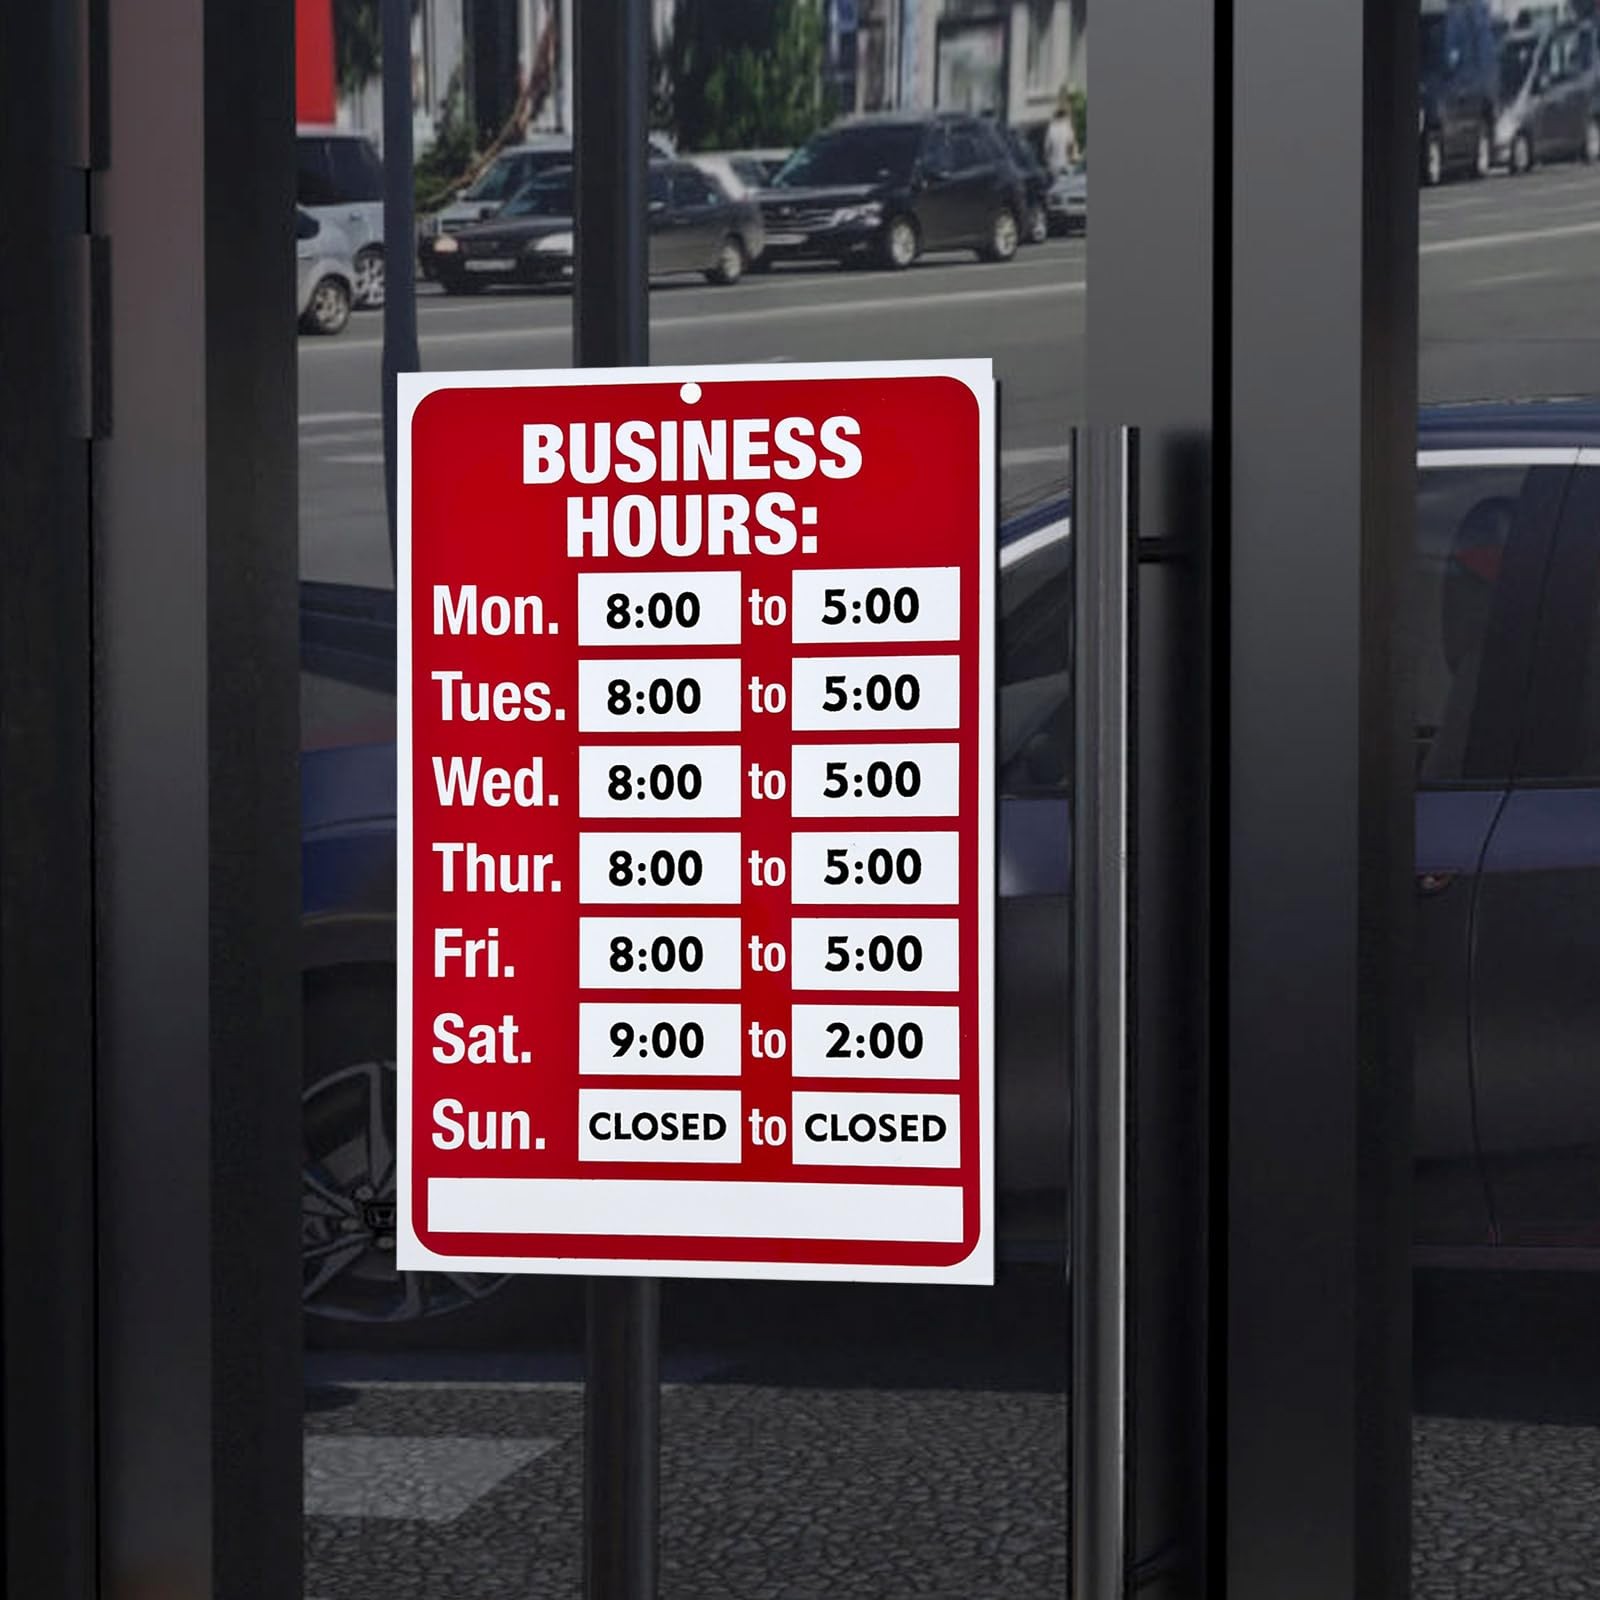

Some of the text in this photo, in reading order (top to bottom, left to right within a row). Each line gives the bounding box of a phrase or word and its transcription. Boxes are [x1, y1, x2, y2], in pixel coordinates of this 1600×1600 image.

[524, 416, 862, 484] BUSINESS
[567, 492, 817, 557] HOURS:
[434, 585, 919, 635] Mon. 8:00 to 5:00
[432, 671, 920, 721] Tues. 8:00 to 5:00
[432, 757, 920, 807] Wed. 8:00 to 5:00
[433, 843, 921, 892] Thur. 8:00 to 5:00
[435, 928, 922, 977] Fri. 8:00 to 5:00
[433, 1013, 923, 1064] Sat. 9:00 to 2:00
[432, 1099, 946, 1150] Sun. CLOSED to CLOSED
